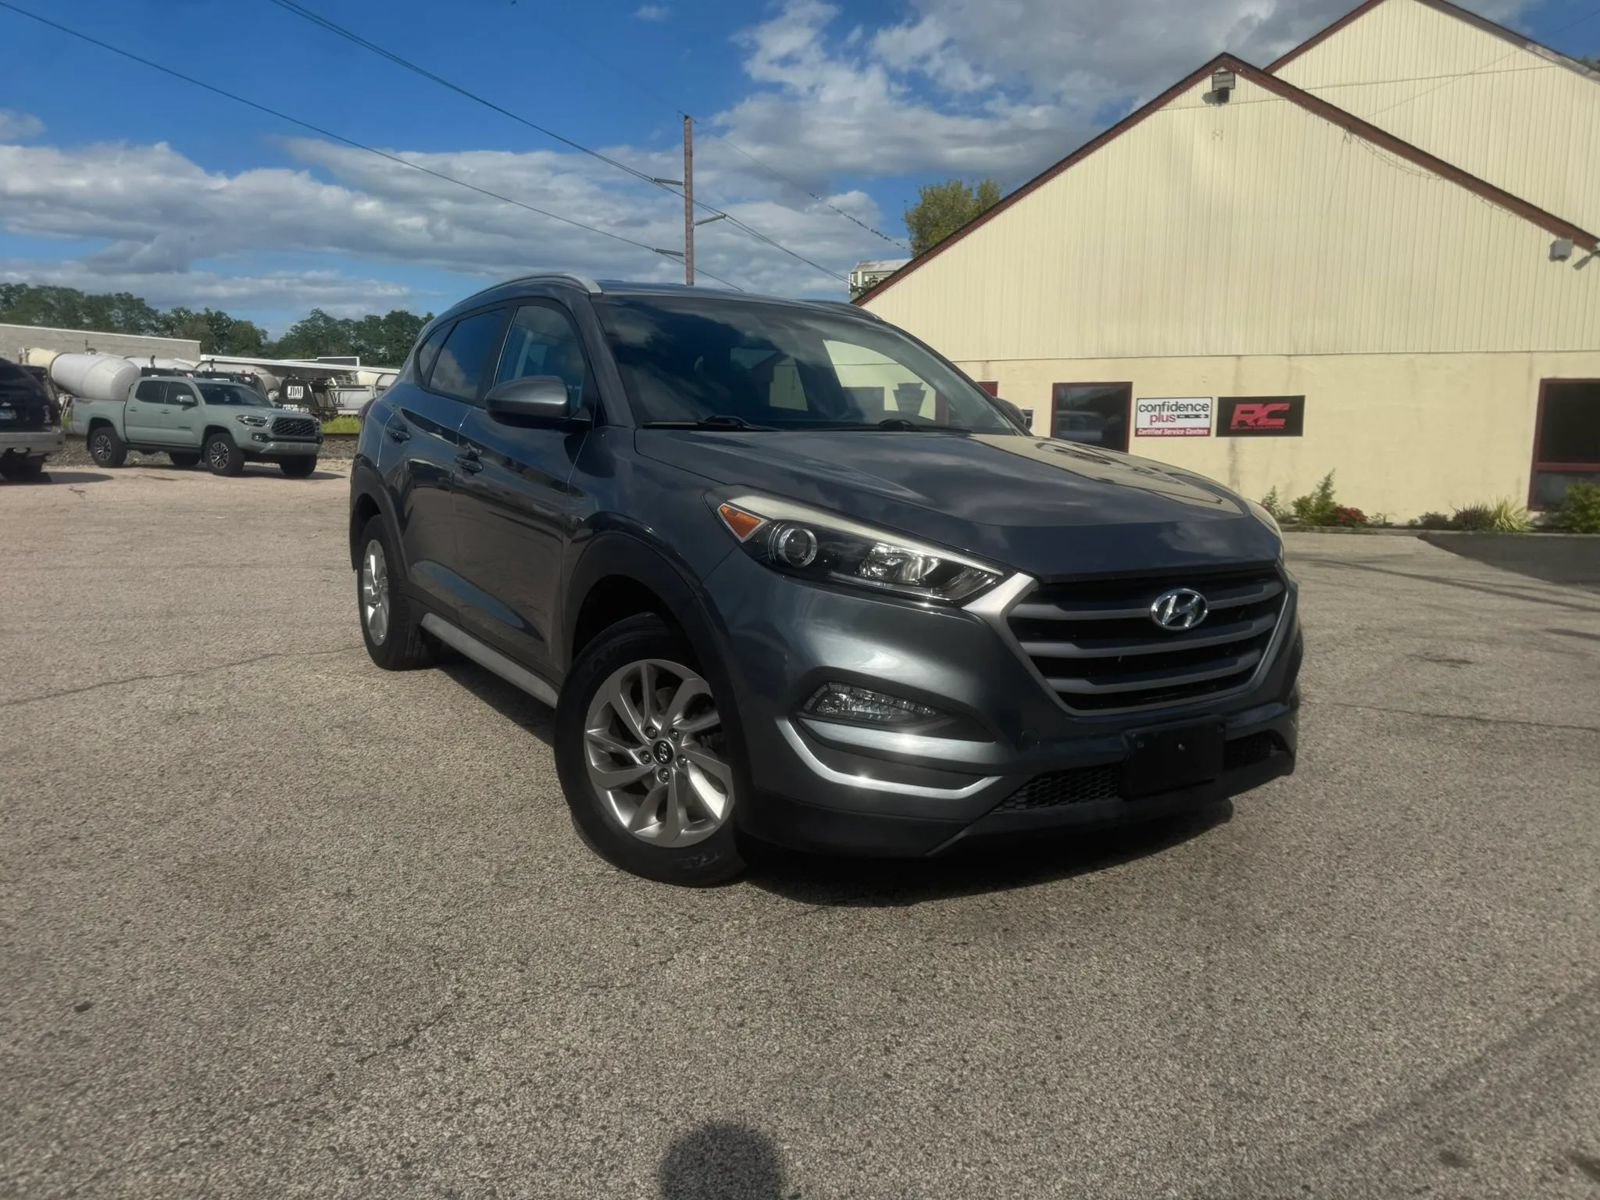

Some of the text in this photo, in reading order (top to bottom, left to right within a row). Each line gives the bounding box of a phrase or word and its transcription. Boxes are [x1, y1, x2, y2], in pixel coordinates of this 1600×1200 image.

[1138, 401, 1210, 413] confidence
[1149, 414, 1177, 425] plus
[1231, 403, 1290, 427] RC
